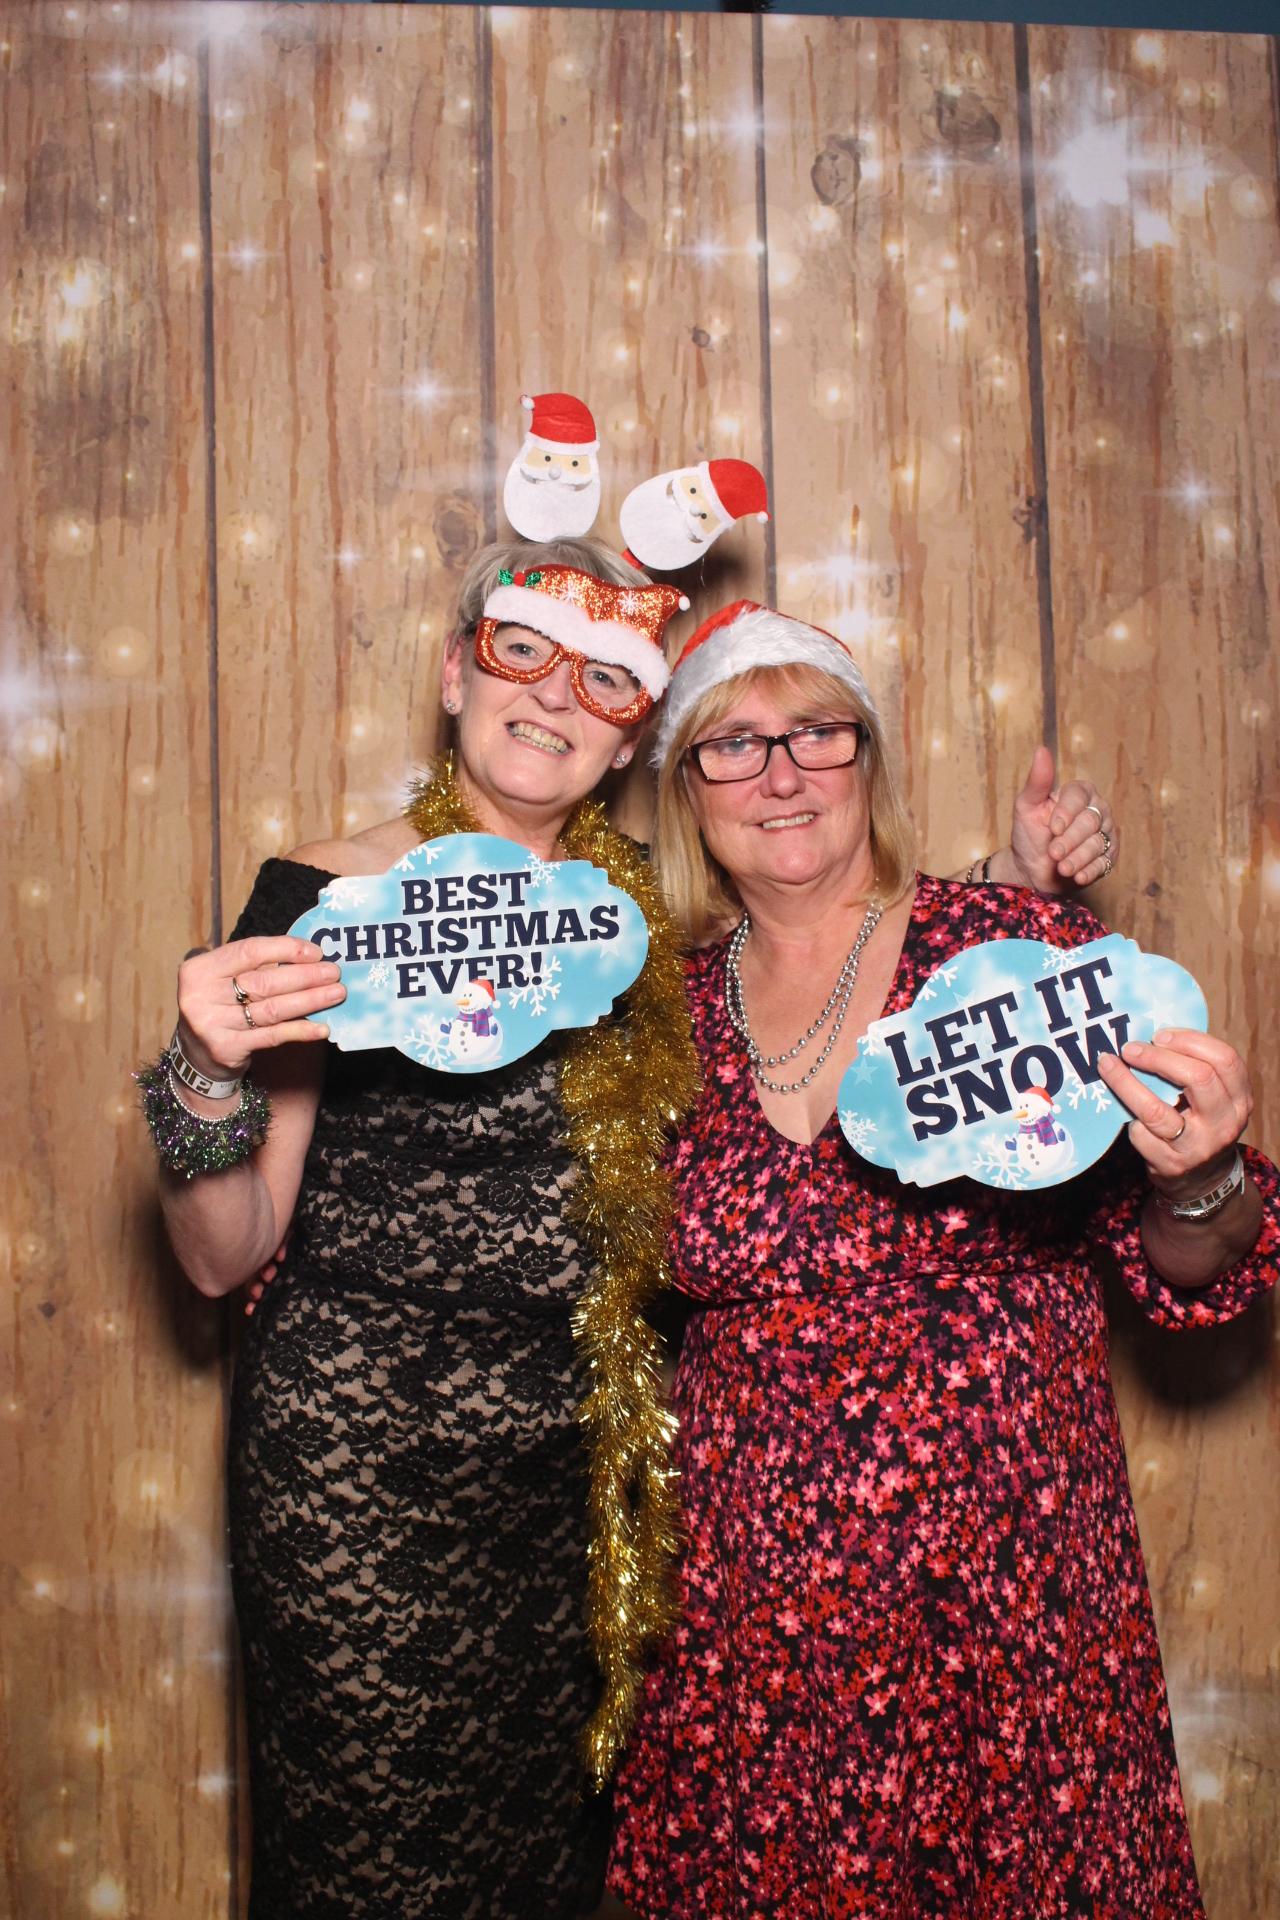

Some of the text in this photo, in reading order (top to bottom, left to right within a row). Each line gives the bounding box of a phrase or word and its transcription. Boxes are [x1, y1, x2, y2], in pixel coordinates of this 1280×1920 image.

[401, 871, 532, 915] BEST
[310, 905, 620, 963] CHRISTMAS
[396, 952, 543, 998] EVER!
[885, 957, 1113, 1086] LET IT
[906, 1013, 1131, 1141] SNOW
